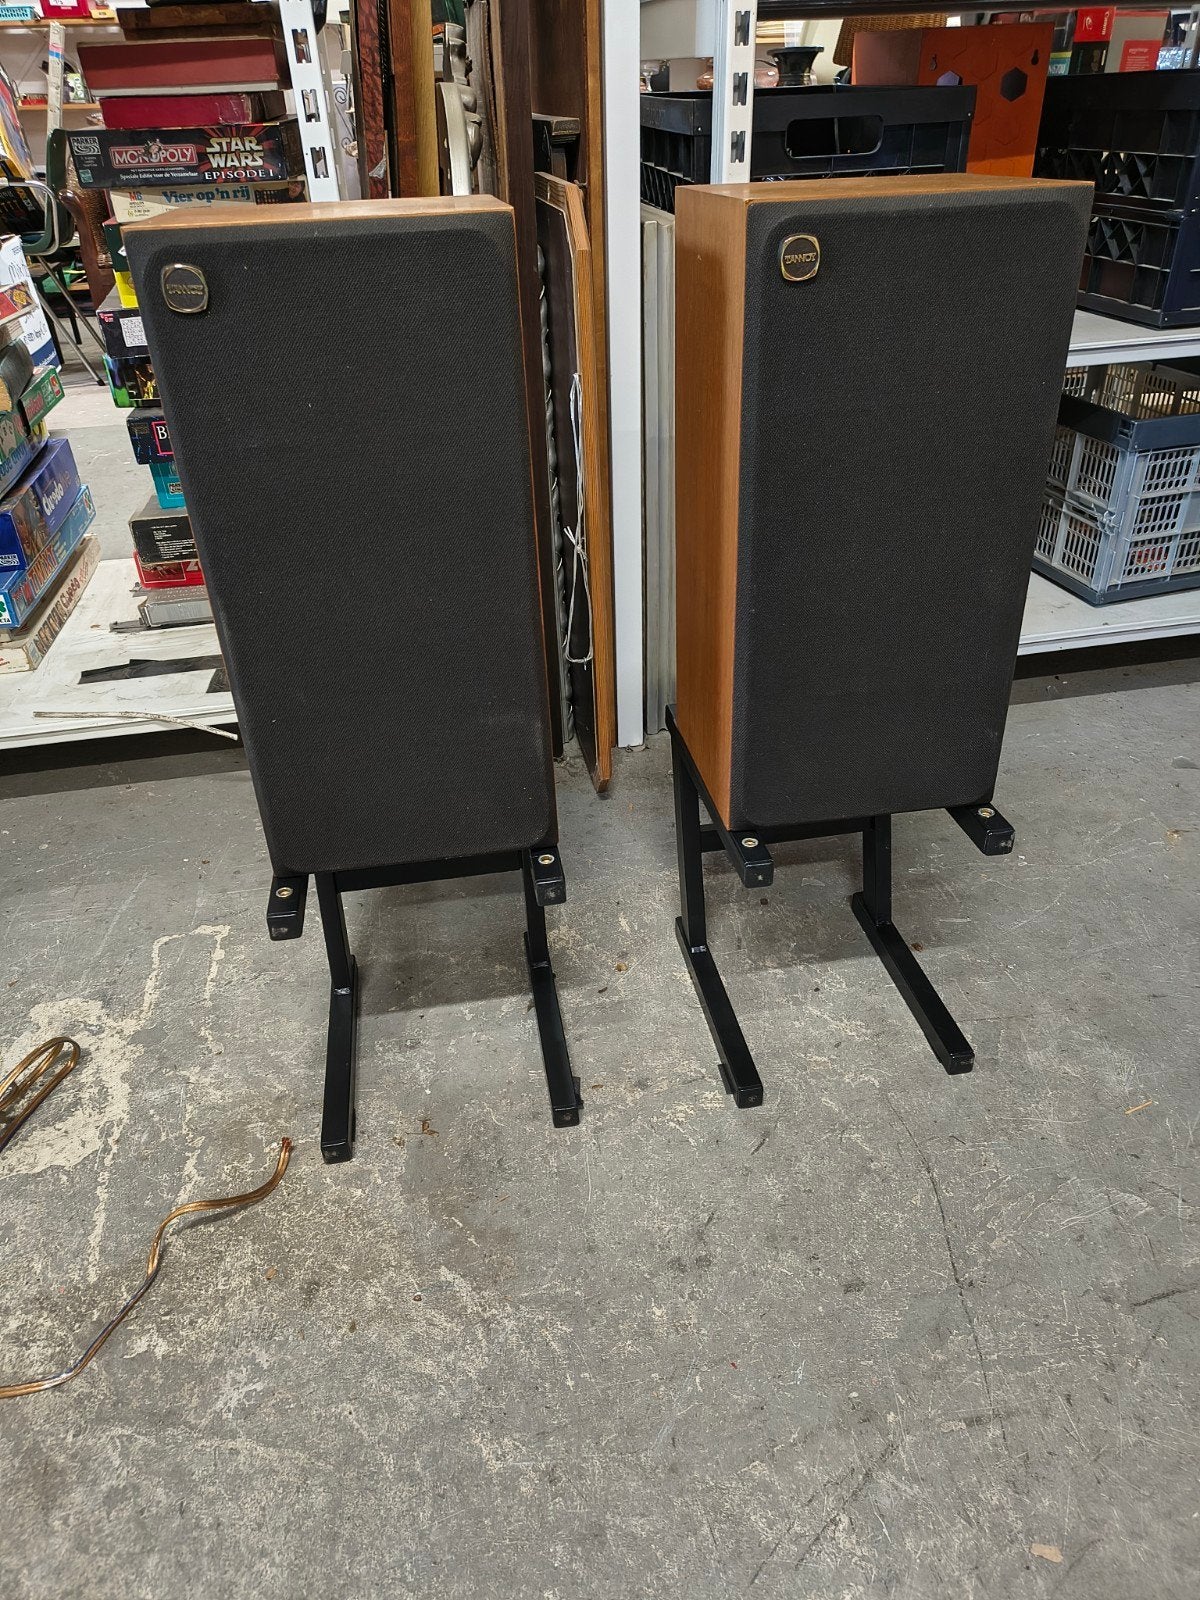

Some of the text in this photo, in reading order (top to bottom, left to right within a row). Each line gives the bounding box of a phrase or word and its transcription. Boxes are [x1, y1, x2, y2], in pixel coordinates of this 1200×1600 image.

[206, 137, 263, 153] STAR
[114, 148, 193, 165] MONOPOLY
[207, 152, 264, 168] WARS
[205, 170, 263, 180] EPISODE
[162, 191, 193, 203] Vier
[232, 186, 251, 201] rij
[784, 252, 817, 264] TANNOY
